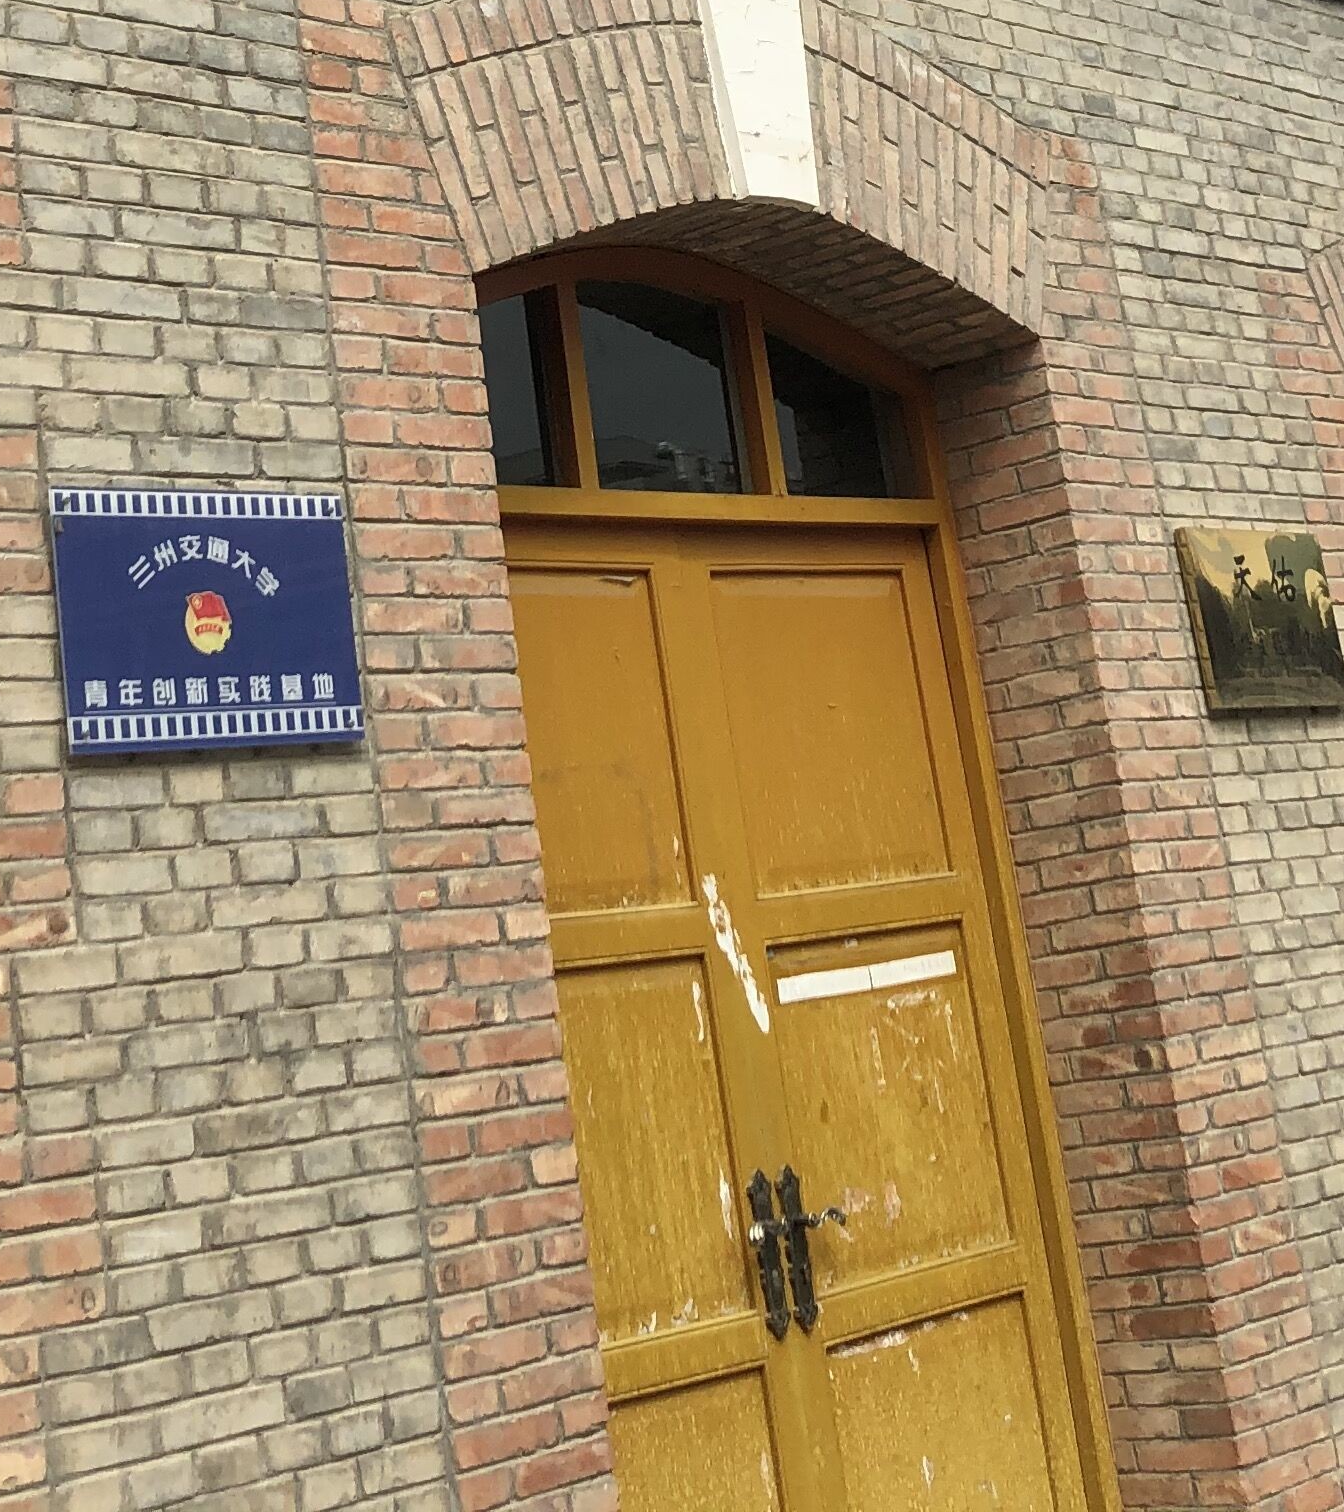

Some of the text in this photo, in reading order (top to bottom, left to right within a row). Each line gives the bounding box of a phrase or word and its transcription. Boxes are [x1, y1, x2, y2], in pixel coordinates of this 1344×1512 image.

[128, 534, 280, 597] 兰州交通大学
[84, 672, 335, 709] 青年创新实践基地
